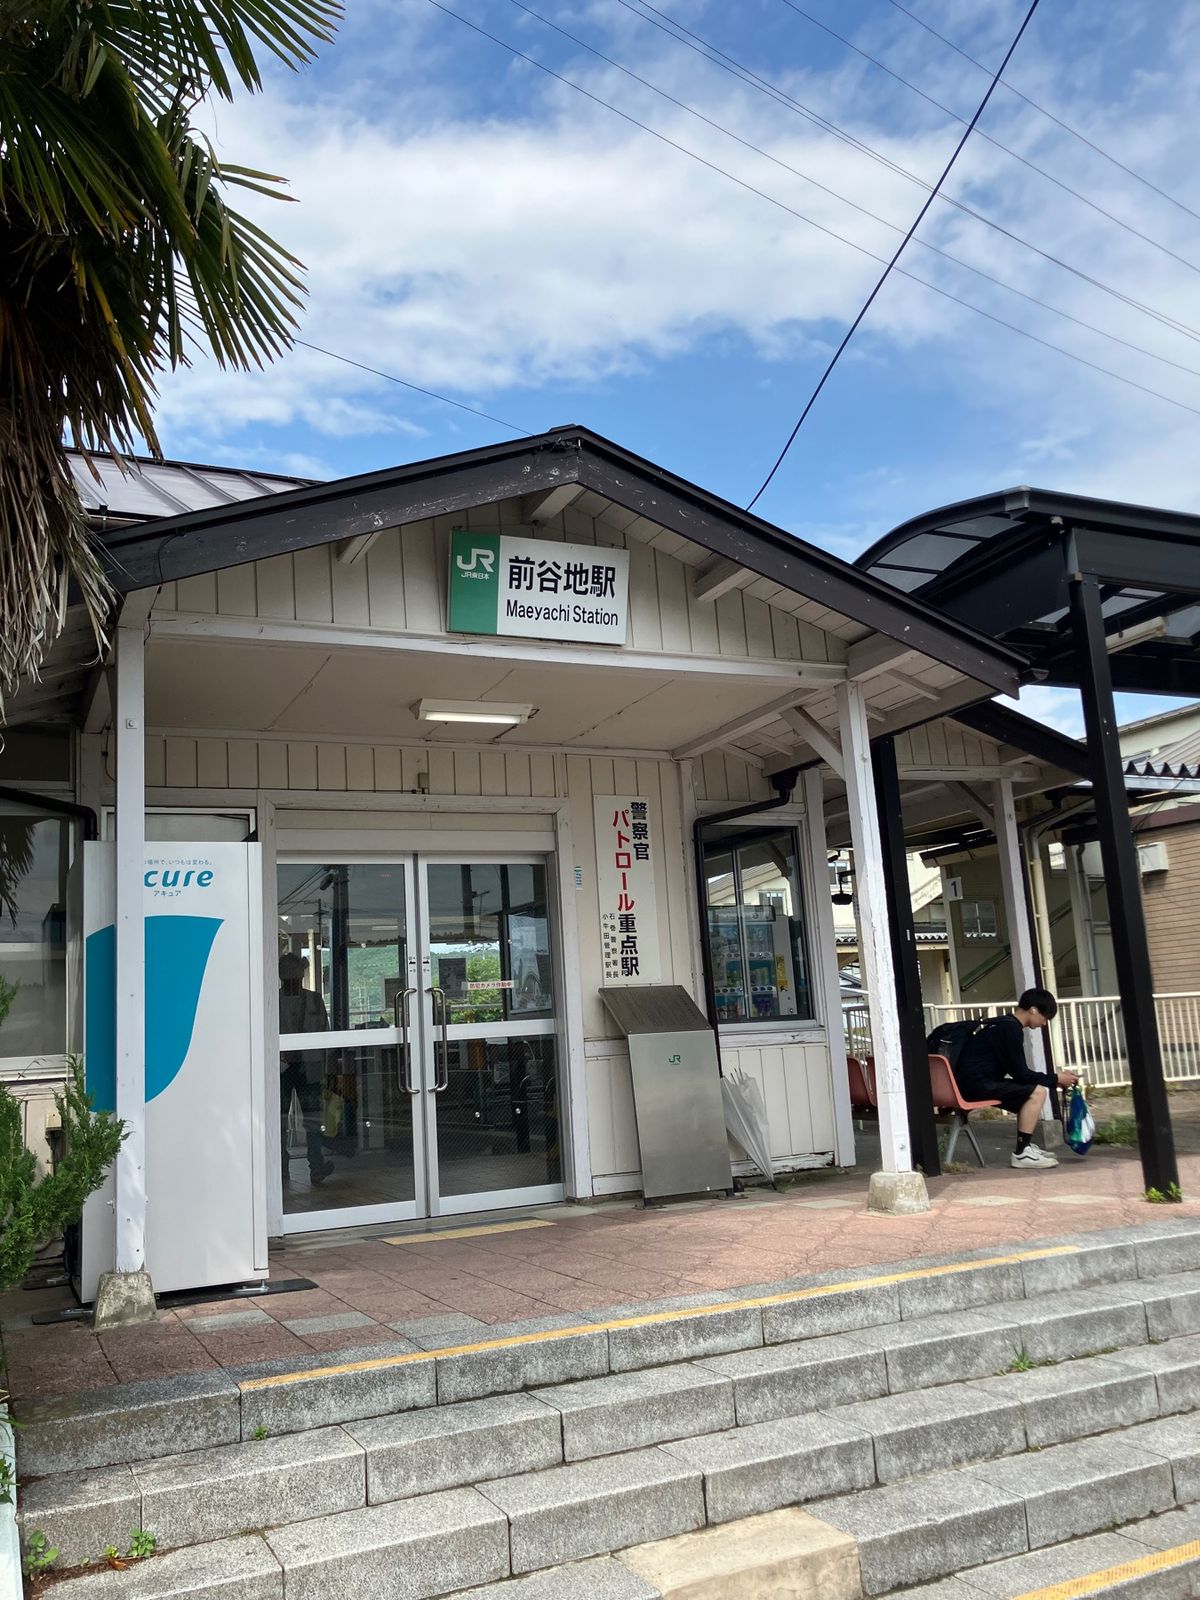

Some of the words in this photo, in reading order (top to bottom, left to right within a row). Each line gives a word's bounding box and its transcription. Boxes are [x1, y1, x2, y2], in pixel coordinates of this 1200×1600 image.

[456, 548, 495, 573] JR
[460, 571, 490, 580] JR東日本
[508, 556, 616, 598] 前谷地駅
[506, 599, 570, 622] Maeyachi
[573, 605, 619, 626] Station
[630, 801, 650, 861] 警察官
[153, 889, 182, 897] アキュア
[612, 808, 640, 977] パトロール重点駅
[951, 880, 958, 897] 1
[602, 913, 612, 979] 小牛田管理駅長
[609, 912, 619, 978] 石巻警察署長
[668, 1054, 681, 1063] JR
